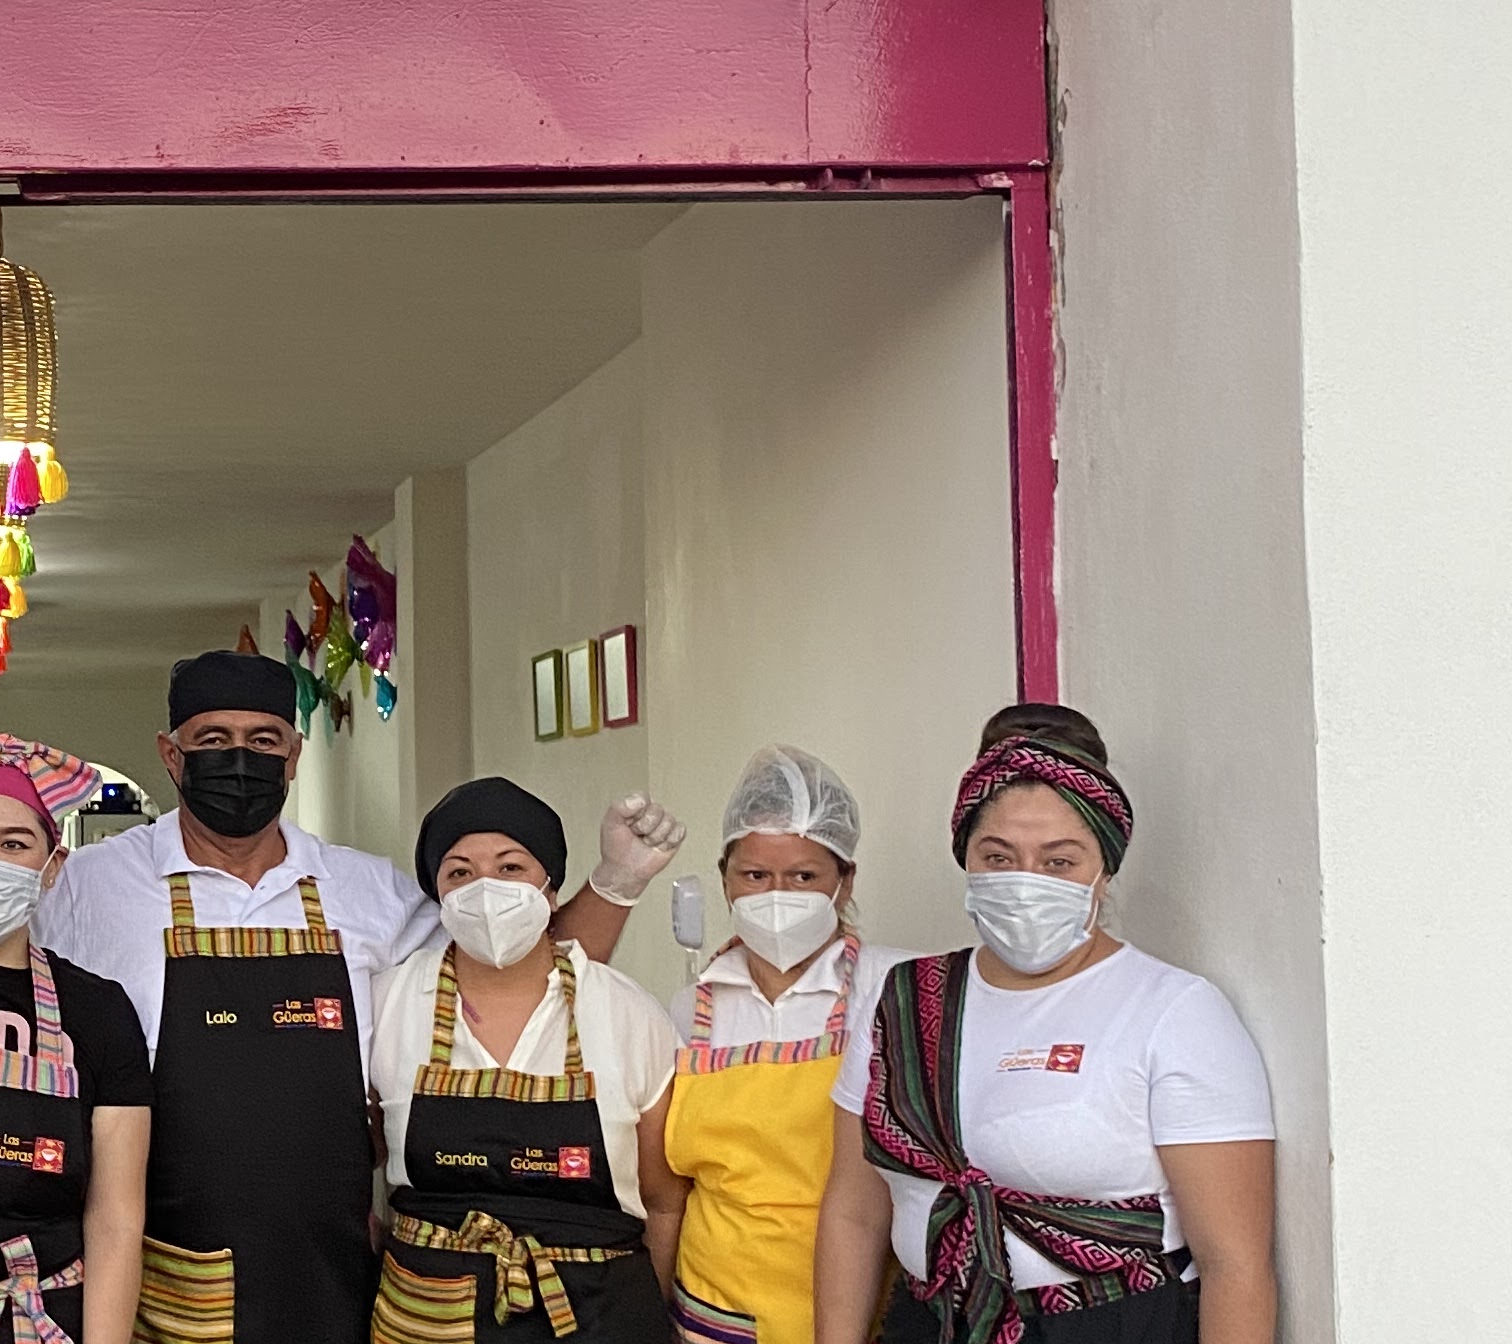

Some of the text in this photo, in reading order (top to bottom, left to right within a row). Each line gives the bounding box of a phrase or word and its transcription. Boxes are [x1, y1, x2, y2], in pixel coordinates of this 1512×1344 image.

[285, 999, 302, 1010] Las
[205, 1010, 238, 1025] Lalo
[3, 1133, 20, 1146] Las
[525, 1146, 544, 1158] Las
[434, 1151, 489, 1168] Sandra
[509, 1157, 559, 1173] Güeras
